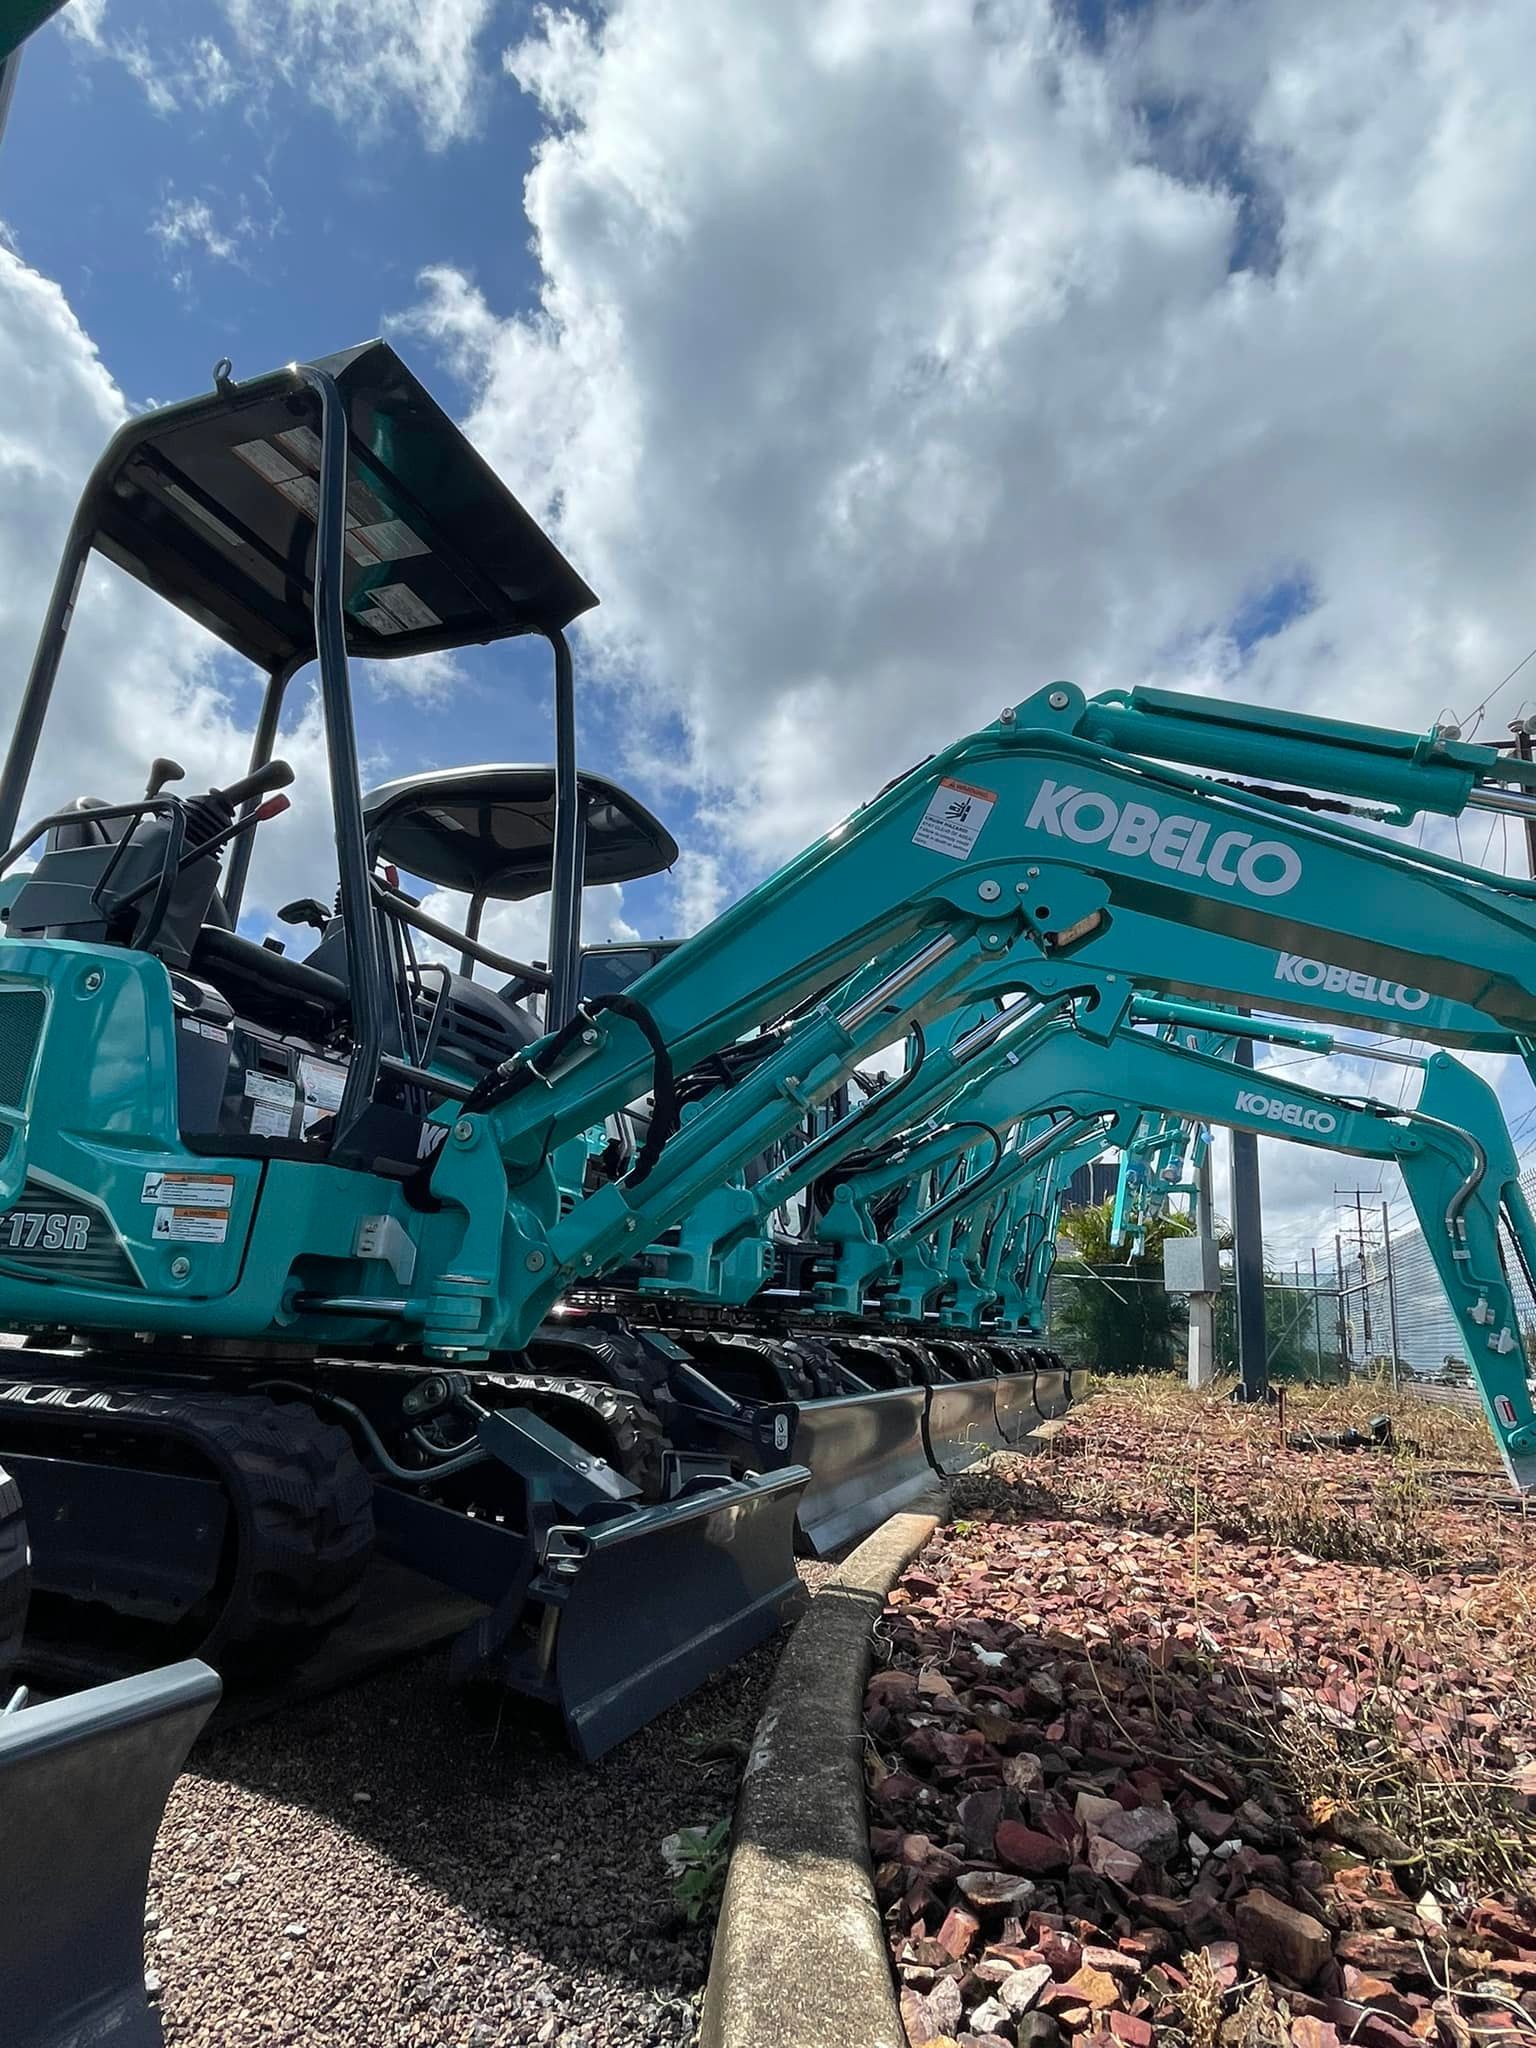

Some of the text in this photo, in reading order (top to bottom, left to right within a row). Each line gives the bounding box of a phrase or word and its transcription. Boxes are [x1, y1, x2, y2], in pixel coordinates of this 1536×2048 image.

[1025, 779, 1302, 896] KOBELCO
[1274, 951, 1430, 1011] KOBELCO
[1235, 1091, 1336, 1134] KOBELCO
[0, 1213, 90, 1250] 17SR
